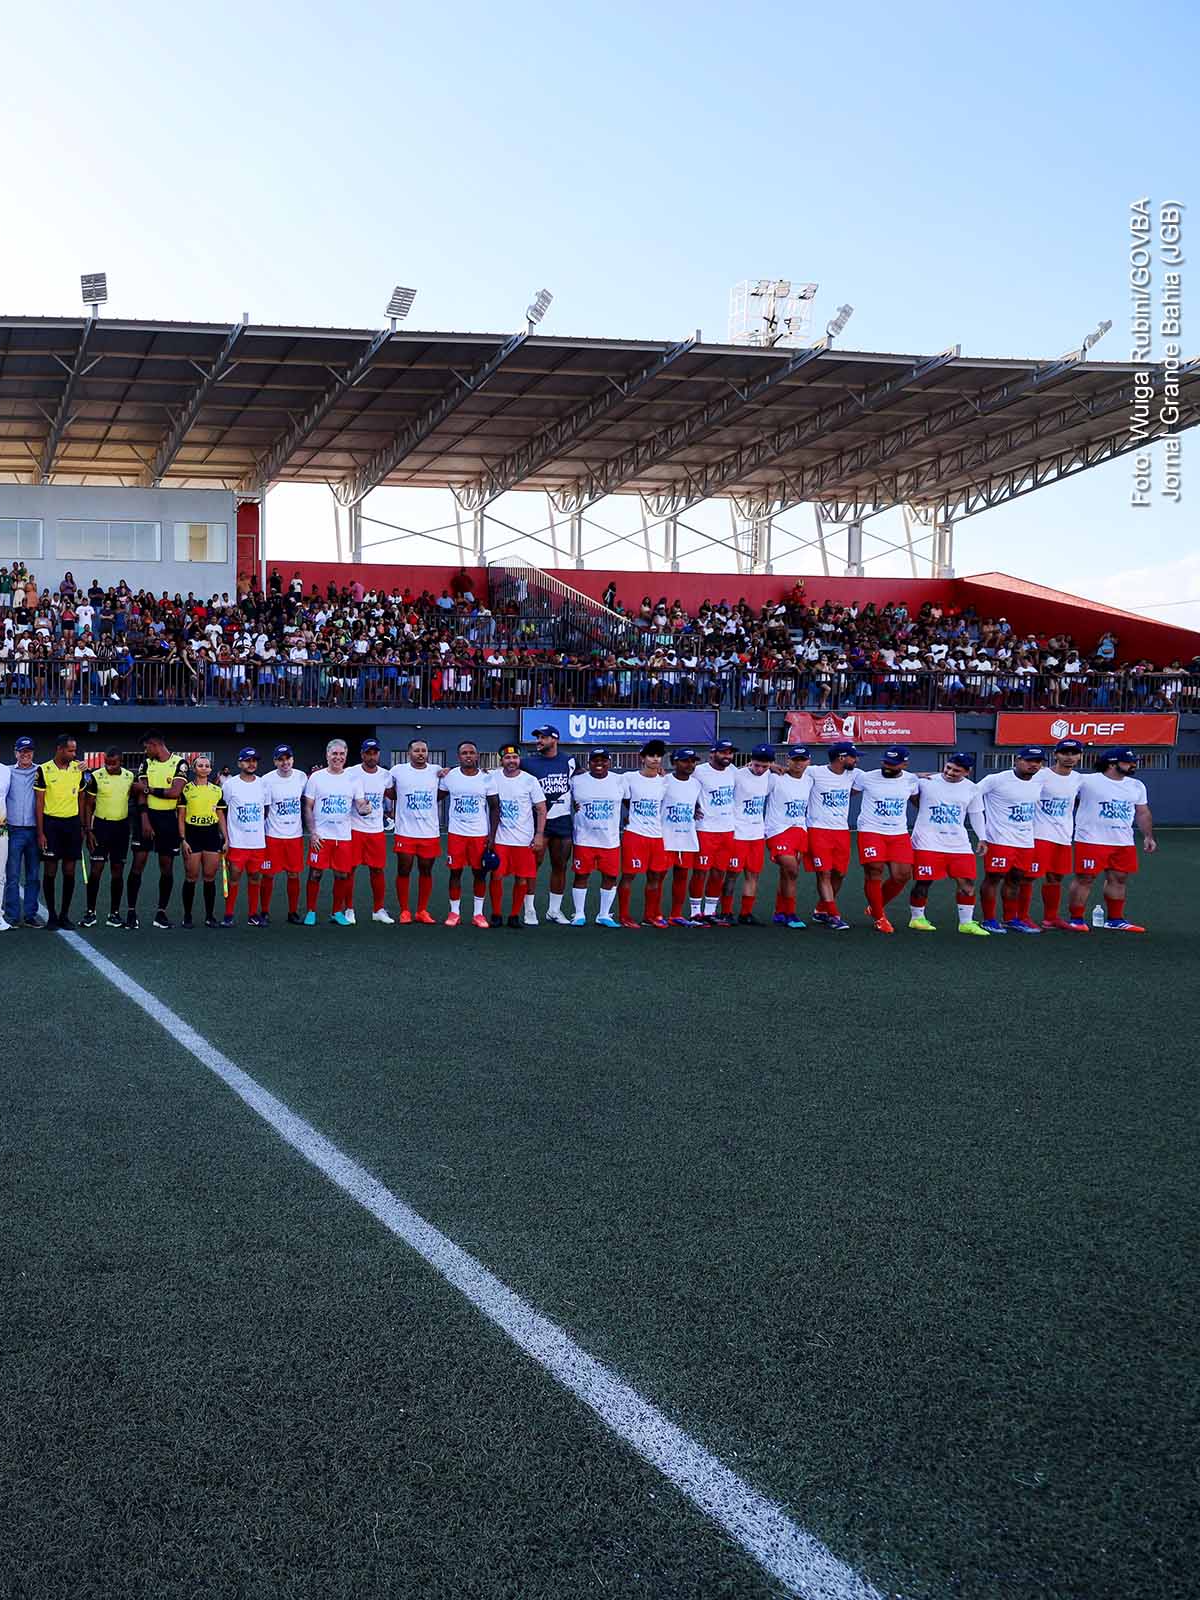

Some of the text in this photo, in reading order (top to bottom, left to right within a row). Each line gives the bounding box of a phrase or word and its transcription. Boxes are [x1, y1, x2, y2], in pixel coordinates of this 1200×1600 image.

[588, 717, 670, 730] União Médica
[1070, 723, 1125, 735] UNEF
[864, 847, 877, 857] 25
[992, 857, 1006, 867] 23
[1083, 859, 1095, 869] 14
[918, 866, 932, 876] 24
